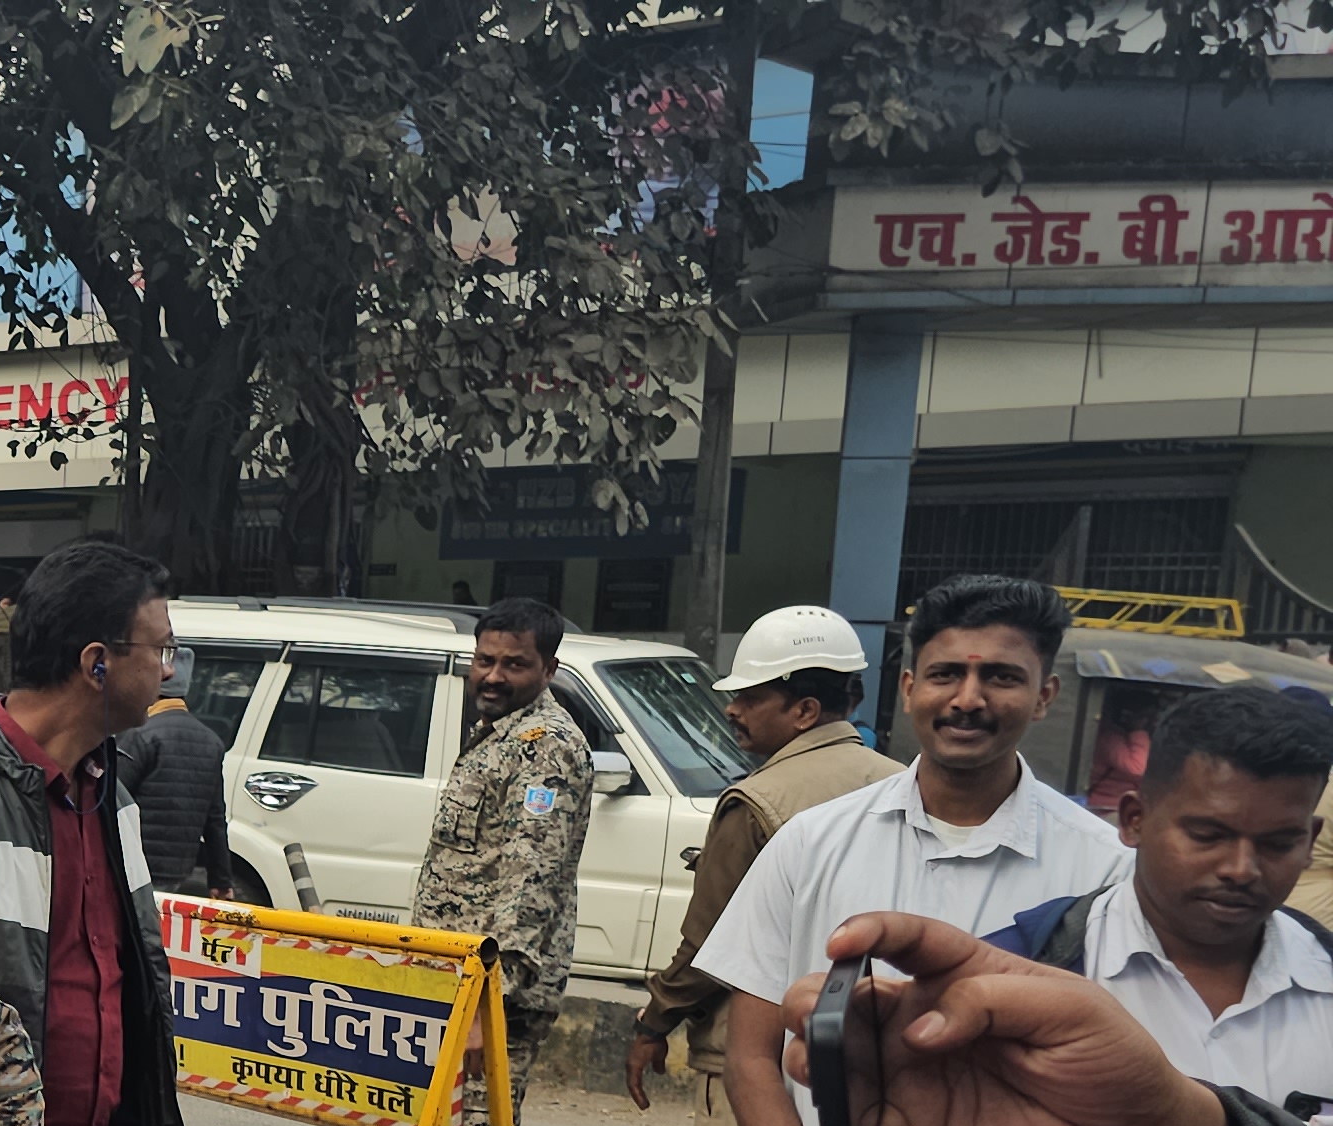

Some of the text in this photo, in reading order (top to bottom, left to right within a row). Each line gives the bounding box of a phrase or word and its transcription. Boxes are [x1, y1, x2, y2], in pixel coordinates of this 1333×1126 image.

[874, 212, 977, 268] एच.
[991, 194, 1100, 266] जेड.
[1117, 193, 1198, 266] बी.
[259, 981, 448, 1067] पुलिस
[230, 1056, 415, 1117] कृपया धीरे चलें
